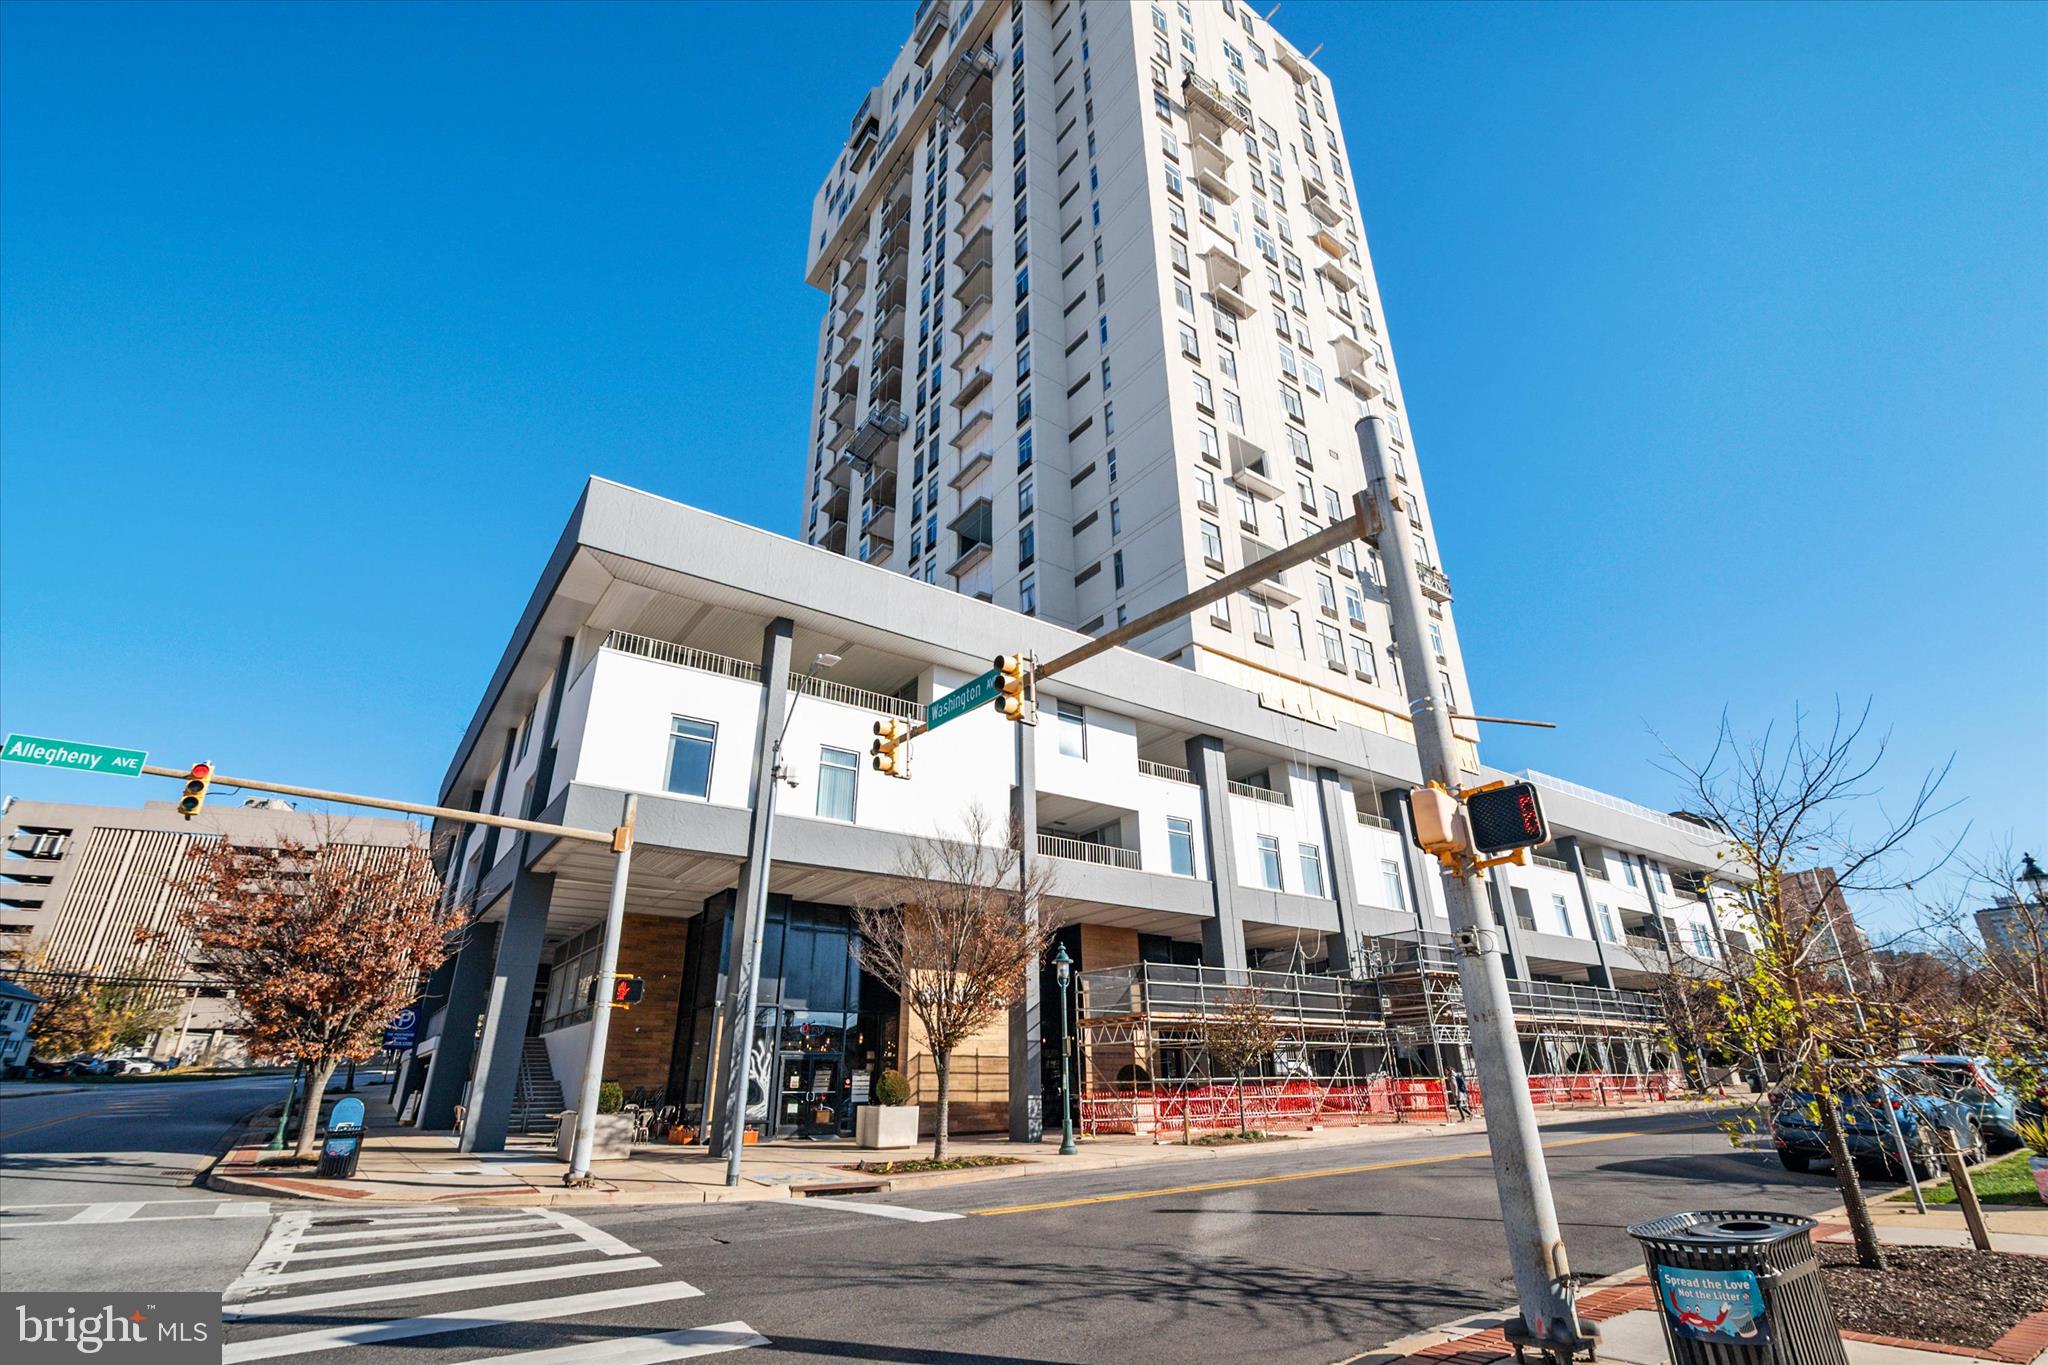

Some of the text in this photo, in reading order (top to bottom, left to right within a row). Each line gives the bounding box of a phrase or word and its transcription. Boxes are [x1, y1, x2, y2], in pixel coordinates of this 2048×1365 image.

[931, 684, 981, 721] Washington
[8, 741, 140, 769] Allegheny AVE
[1664, 1273, 1750, 1290] Spread the Love
[1678, 1288, 1740, 1301] Not the Litter
